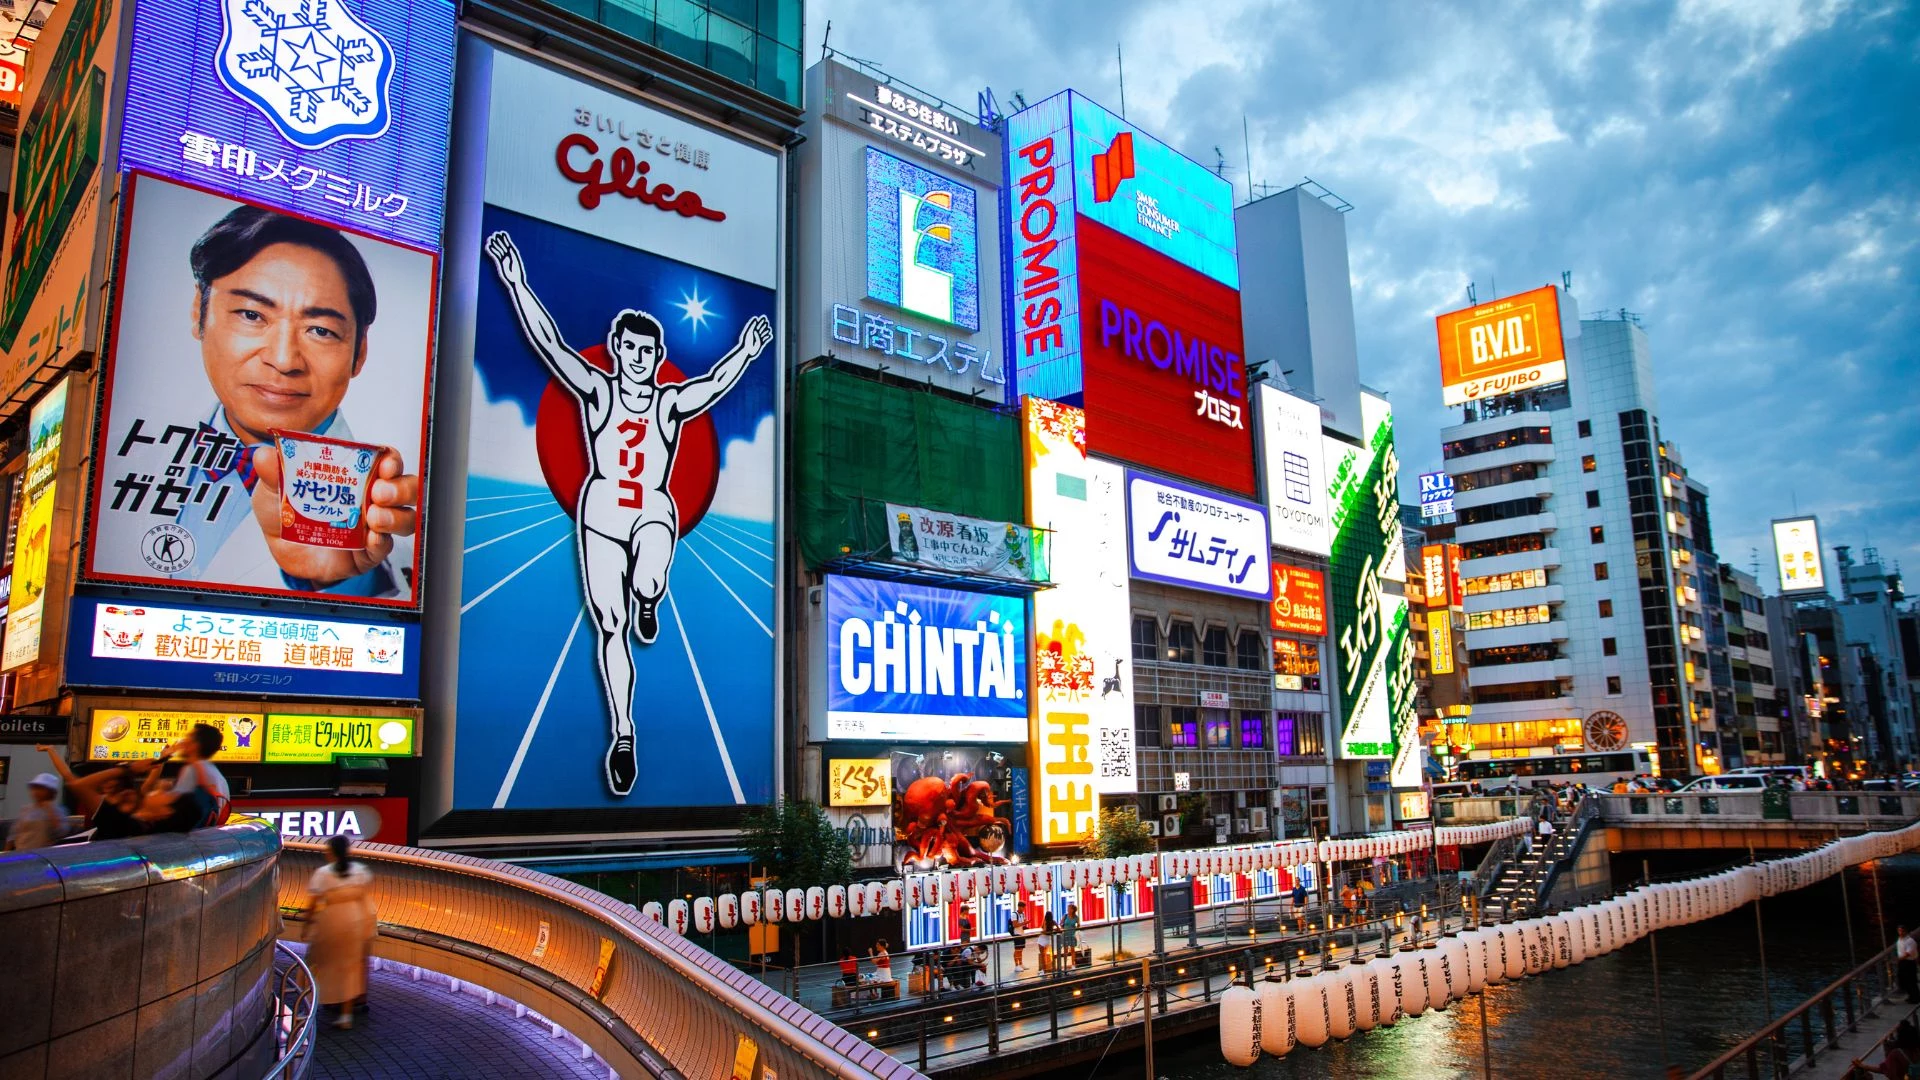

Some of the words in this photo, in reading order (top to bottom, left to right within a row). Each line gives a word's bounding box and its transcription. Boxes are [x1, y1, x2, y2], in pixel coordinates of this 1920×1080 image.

[574, 105, 711, 171] おいしさと健康
[180, 130, 409, 218] 雪印メグミルク
[556, 133, 727, 222] Glico
[1137, 190, 1159, 211] SMBC
[1137, 202, 1181, 233] CONSUMER
[1138, 214, 1173, 240] FINANCE
[1018, 137, 1063, 358] PROMISE
[832, 302, 1007, 386] 日商エステム
[1101, 297, 1242, 398] PROMISE
[1470, 316, 1531, 365] B.V.D.
[1483, 370, 1541, 393] FUJIBO
[1194, 390, 1244, 431] プロミス
[117, 419, 239, 472] トクホ
[165, 464, 184, 477] の
[617, 417, 649, 510] グリコ
[109, 473, 232, 522] ガセリ
[1275, 504, 1324, 528] TOYOTOMI
[172, 614, 340, 642] ようこそ道頓堀へ
[155, 634, 262, 662] 歡迎光臨
[283, 643, 354, 668] 道頓堀
[213, 671, 293, 685] 雪印メグミルク
[0, 719, 45, 732] oilets
[271, 723, 313, 744] 賃貸・売買
[315, 720, 373, 748] ピタットハウス
[1045, 711, 1094, 842] 玉出
[241, 810, 361, 836] TERIA
